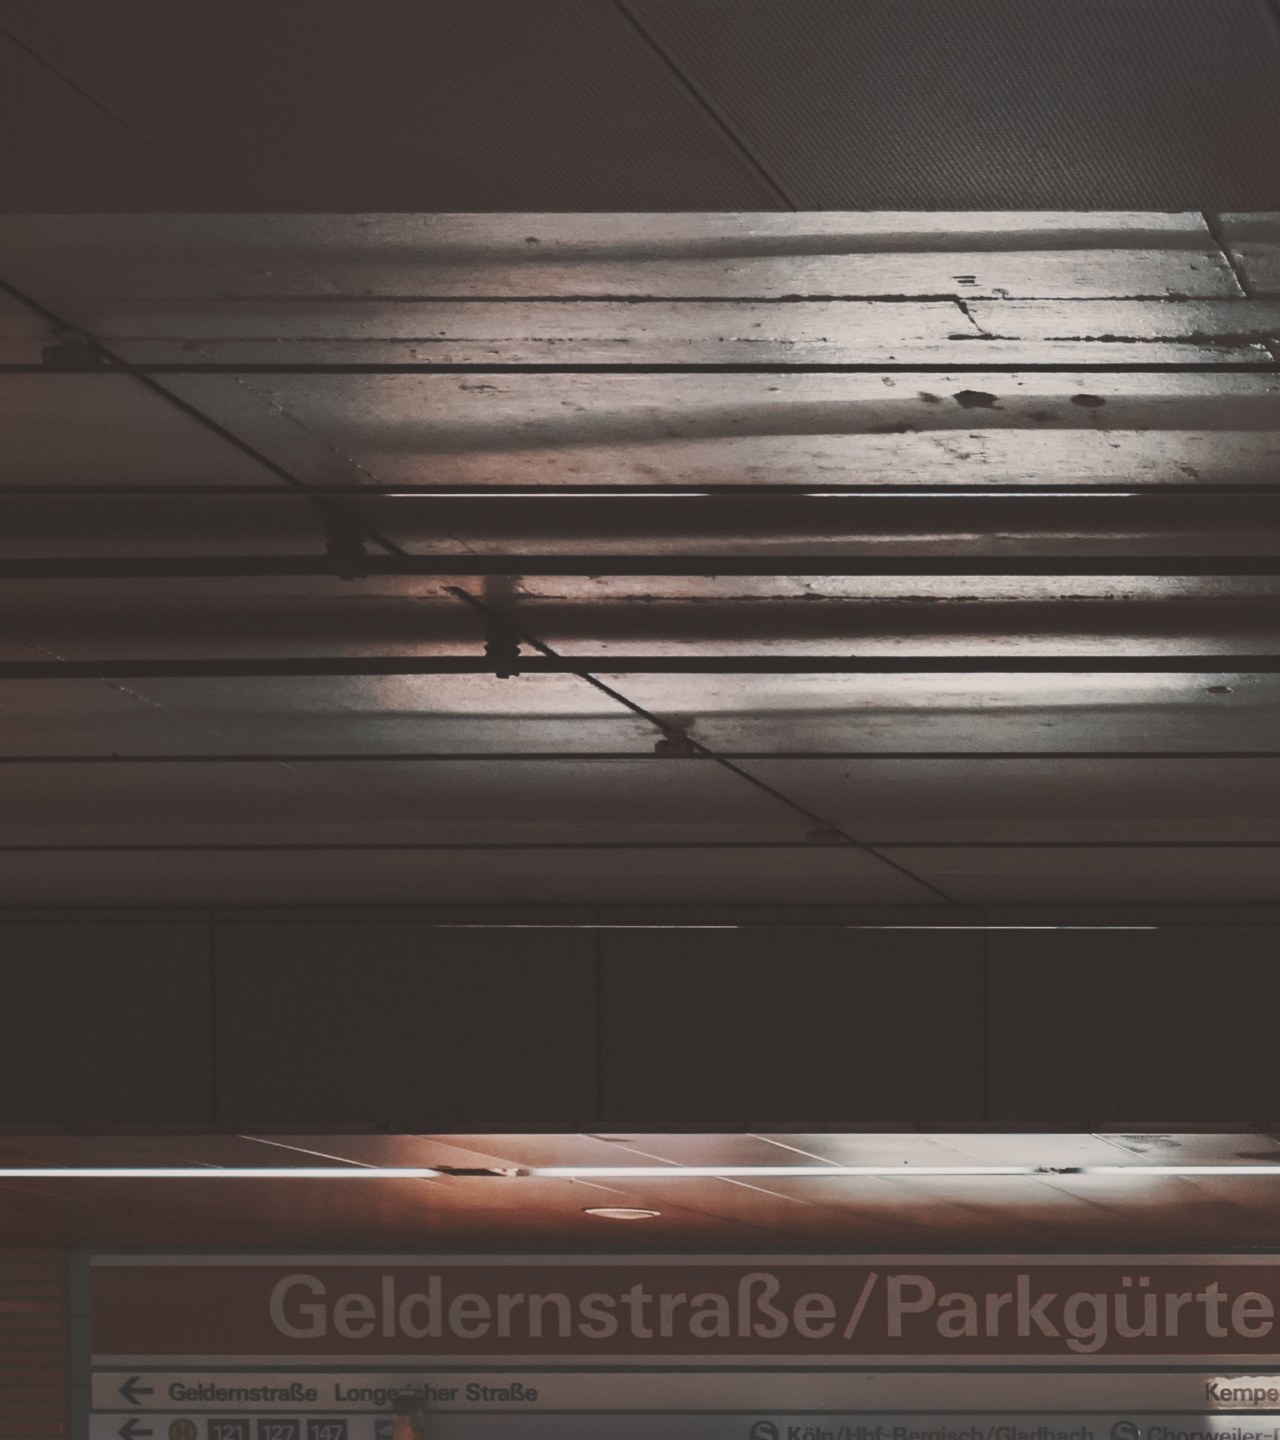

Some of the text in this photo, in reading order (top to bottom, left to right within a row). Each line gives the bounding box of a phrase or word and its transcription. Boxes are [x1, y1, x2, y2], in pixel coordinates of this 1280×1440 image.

[168, 1382, 318, 1402] Geldernstraße
[335, 1382, 538, 1406] Longecher Straße
